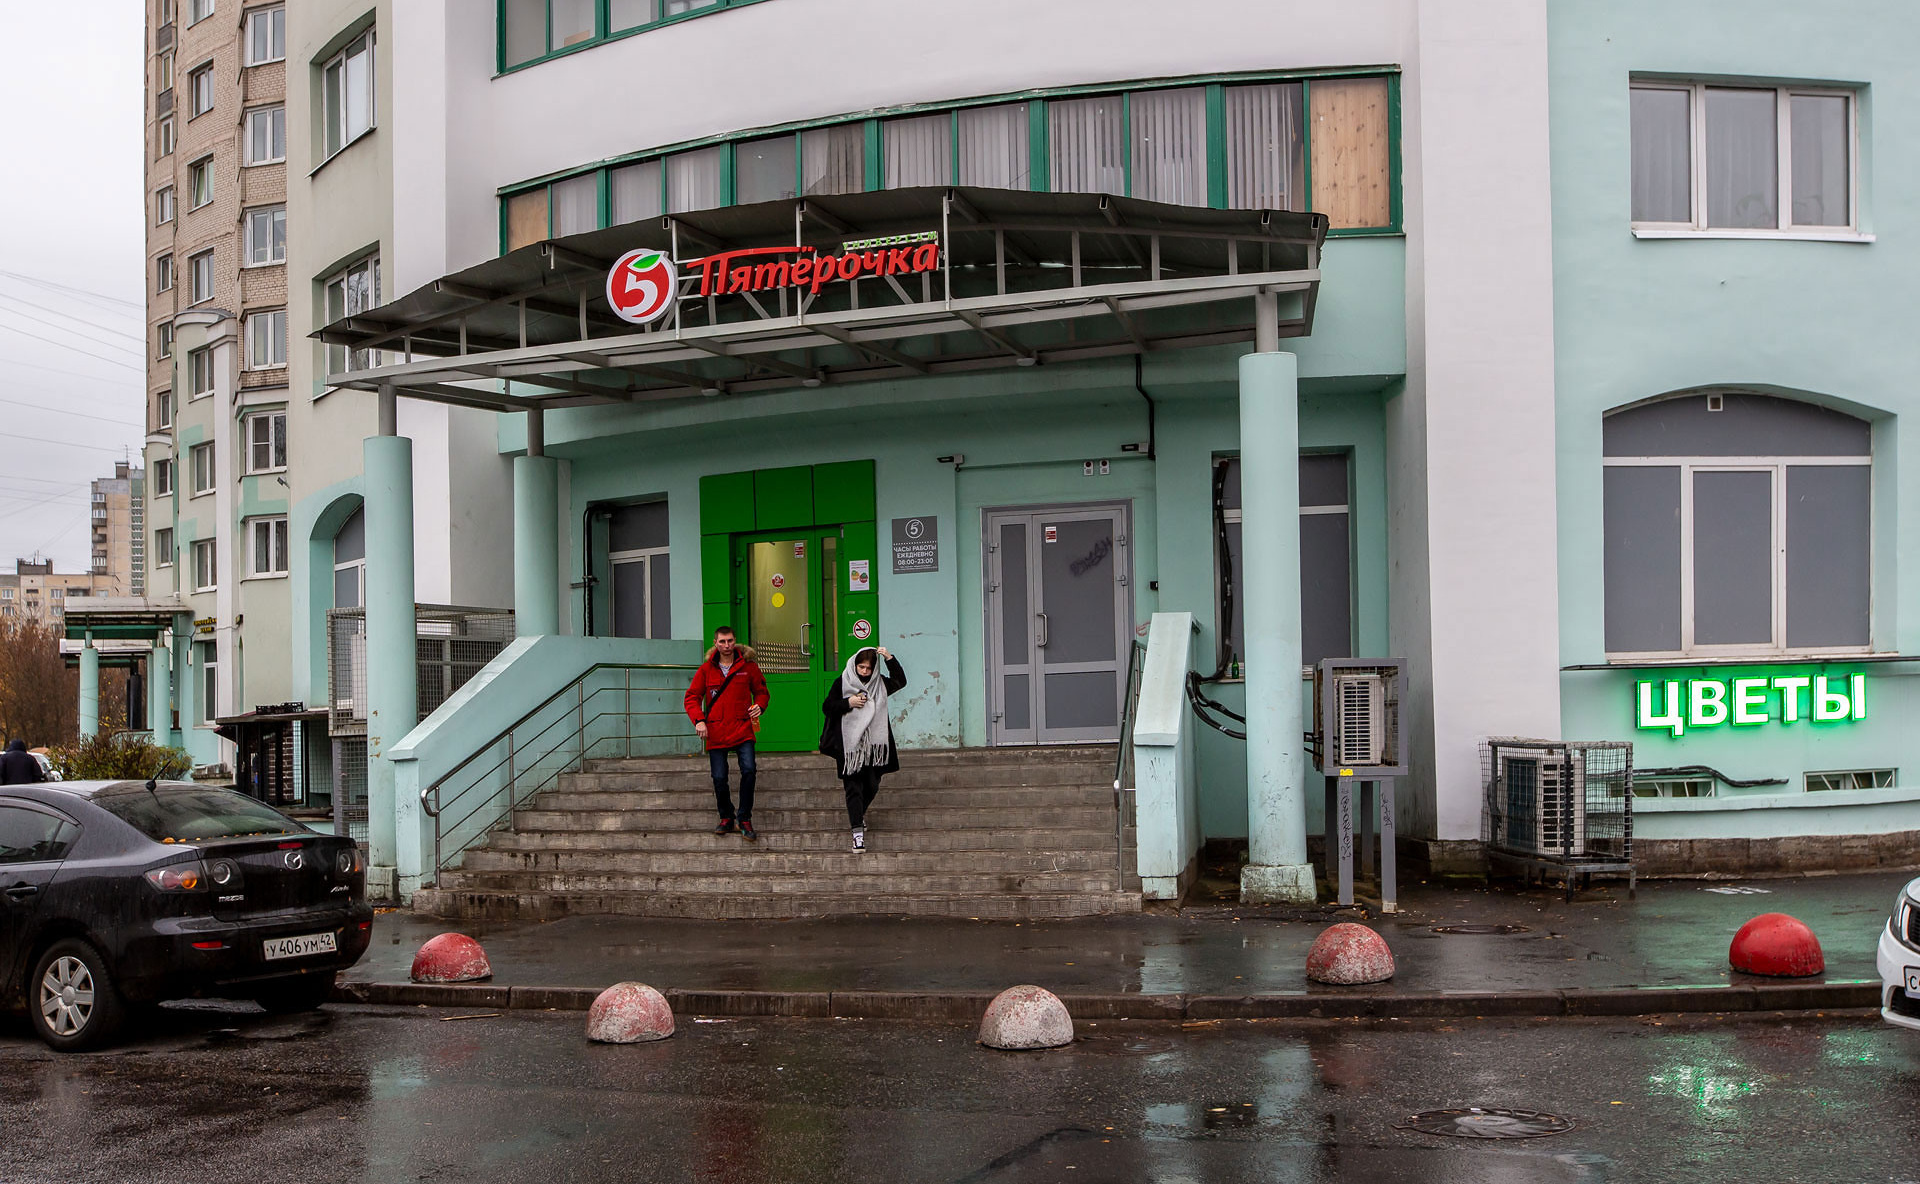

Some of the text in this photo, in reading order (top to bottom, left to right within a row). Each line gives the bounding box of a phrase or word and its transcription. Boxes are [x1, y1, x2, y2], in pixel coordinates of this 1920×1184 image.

[841, 231, 937, 252] УНИВЕРСАМ
[686, 243, 939, 296] Пятёрочка
[896, 551, 934, 559] ЕЖЕДНЕВНО
[912, 544, 937, 552] РАБОТЫ
[1636, 672, 1867, 738] ЦВЕТЫ
[320, 934, 331, 946] 42
